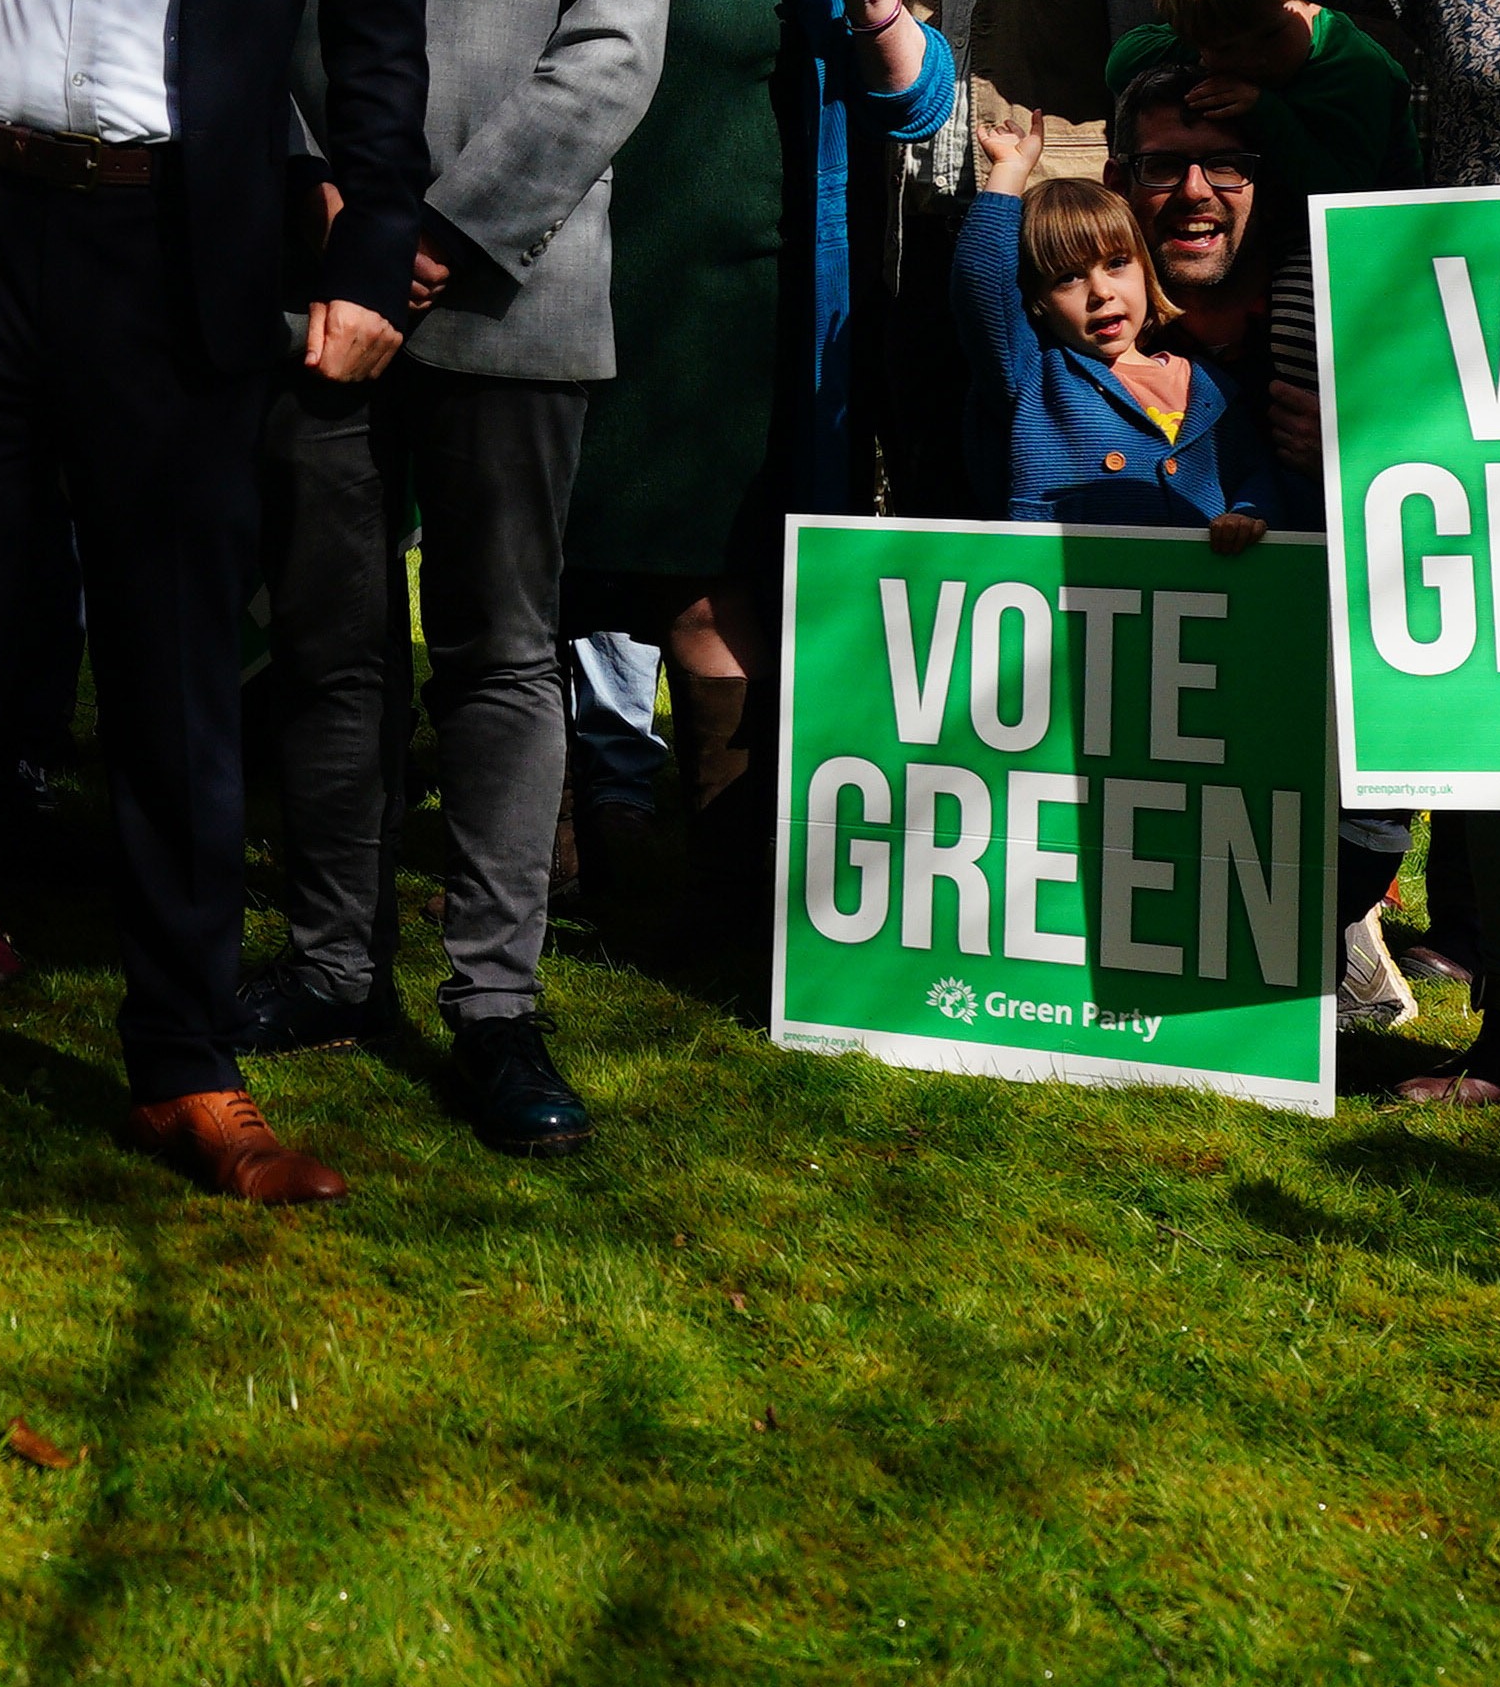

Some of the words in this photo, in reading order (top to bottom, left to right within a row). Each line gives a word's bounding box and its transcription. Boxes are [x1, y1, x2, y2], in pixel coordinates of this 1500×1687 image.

[878, 578, 1228, 768] VOTE
[1356, 783, 1454, 797] greenparty.org.uk
[806, 756, 1300, 989] GREEN
[982, 992, 1073, 1031] Green
[1083, 1002, 1163, 1045] Party
